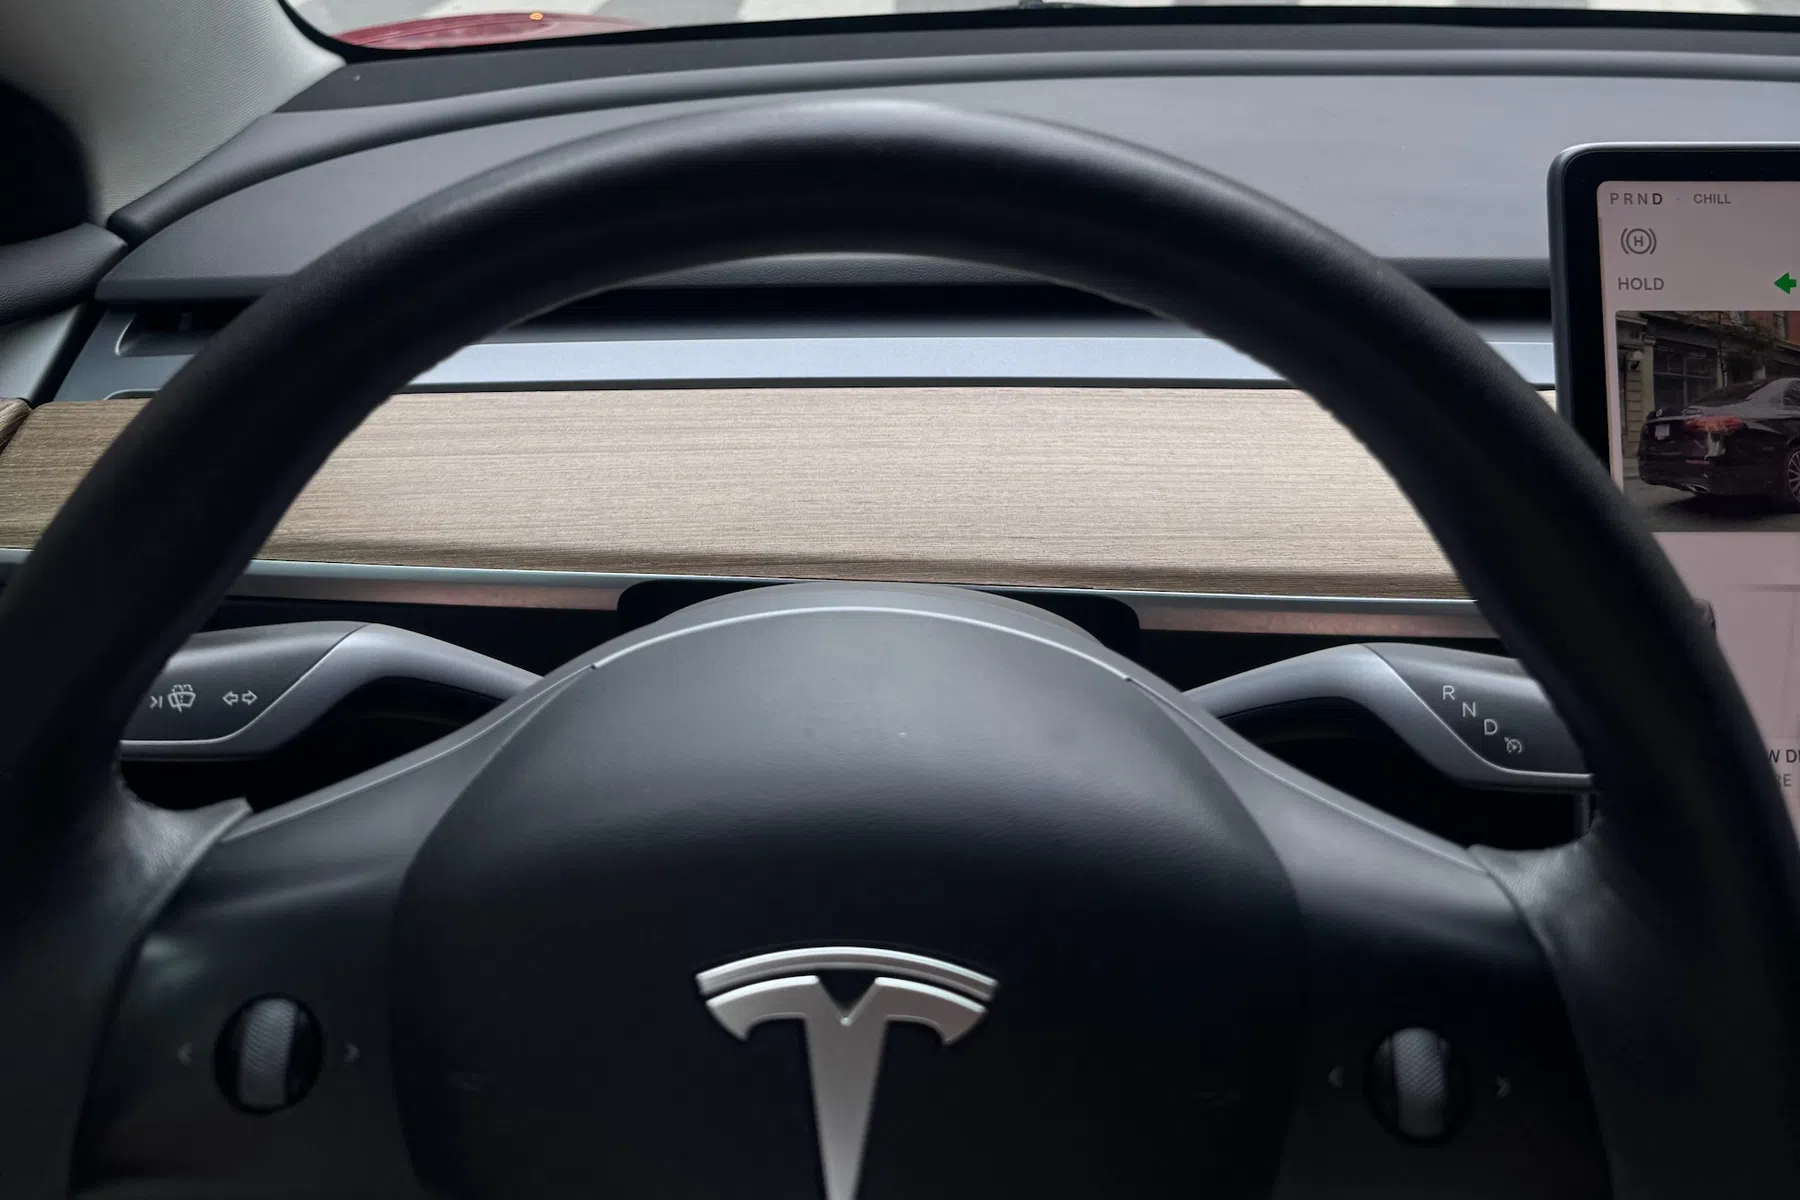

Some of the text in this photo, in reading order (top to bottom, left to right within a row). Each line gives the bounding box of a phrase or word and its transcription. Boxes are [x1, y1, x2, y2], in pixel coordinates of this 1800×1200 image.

[1693, 193, 1732, 205] CHILL
[1618, 277, 1664, 291] HOLD
[1442, 685, 1498, 736] R N D
